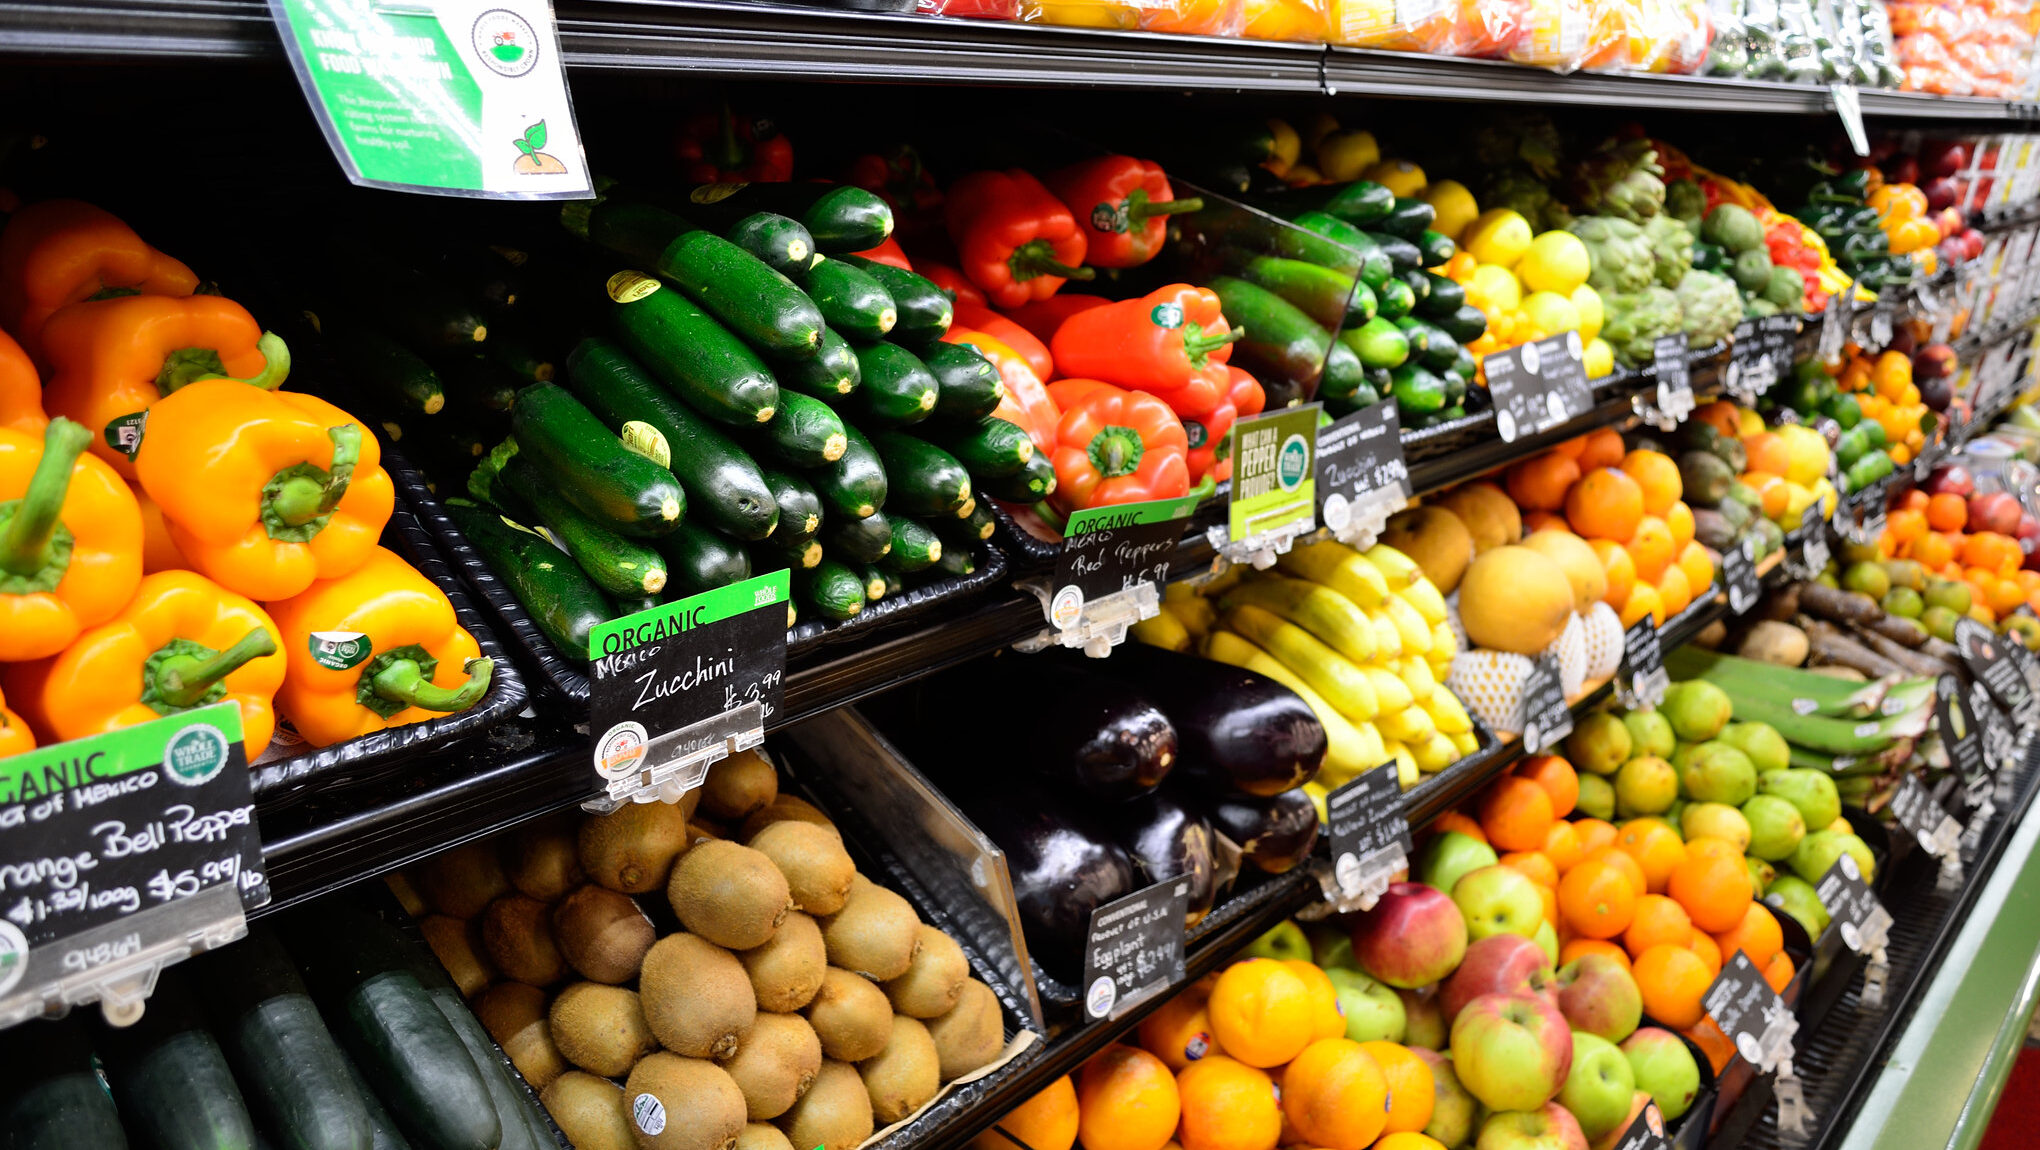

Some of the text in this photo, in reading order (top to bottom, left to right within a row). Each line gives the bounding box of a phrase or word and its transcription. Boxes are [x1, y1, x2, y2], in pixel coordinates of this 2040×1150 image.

[319, 53, 362, 74] FOOD
[1240, 442, 1276, 479] PEPPER
[1074, 511, 1143, 536] ORGANIC
[1114, 537, 1173, 568] Peppers
[602, 605, 706, 656] ORGANIC
[318, 656, 349, 669] ORGANIC
[631, 647, 734, 712] Zucchini
[607, 723, 635, 737] ORGANIC
[174, 738, 215, 757] WHOLE
[176, 750, 217, 767] TRADE
[91, 820, 166, 858] Bell
[164, 804, 256, 844] Pepper
[1093, 932, 1146, 971] Eggplant
